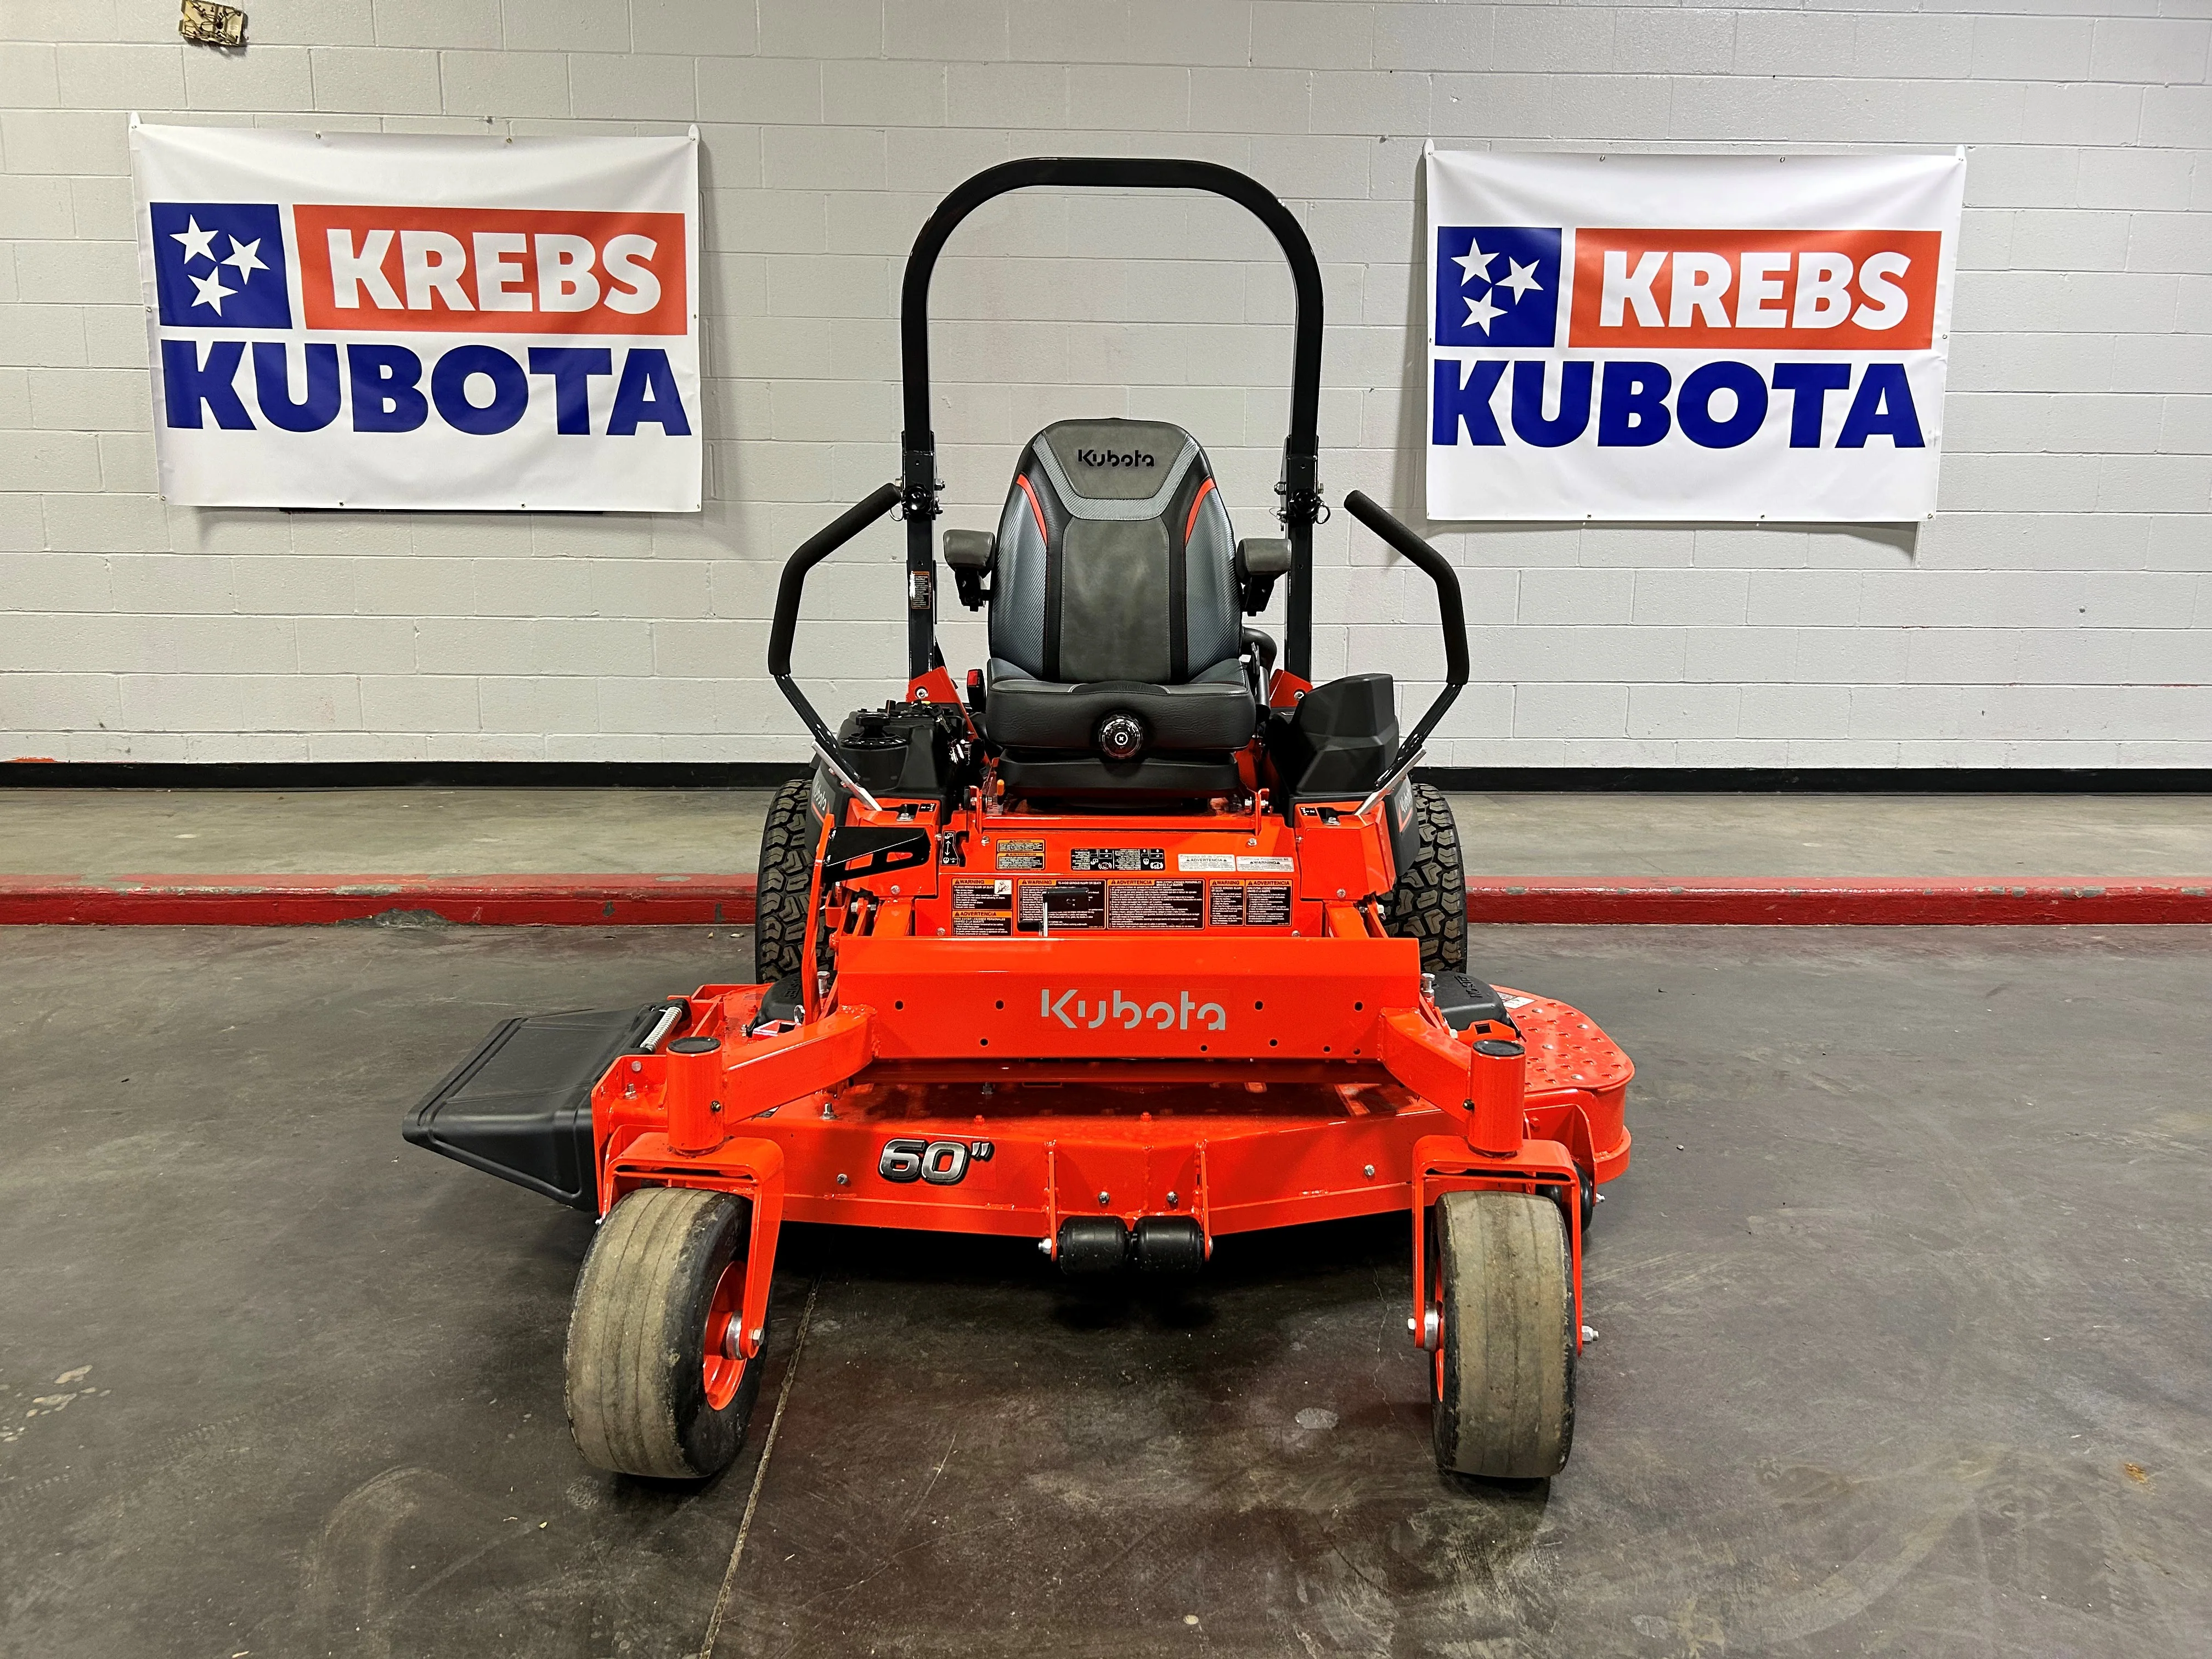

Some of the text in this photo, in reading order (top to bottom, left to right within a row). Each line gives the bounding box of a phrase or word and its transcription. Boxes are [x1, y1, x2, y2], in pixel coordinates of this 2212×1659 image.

[328, 228, 662, 315] KREBS
[1599, 251, 1912, 331] KREBS
[160, 339, 692, 436] KUBOTA
[1432, 359, 1926, 449] KUBOTA
[1078, 449, 1155, 467] Kubota
[1041, 989, 1226, 1031] Kubota
[878, 1137, 995, 1185] 60"
